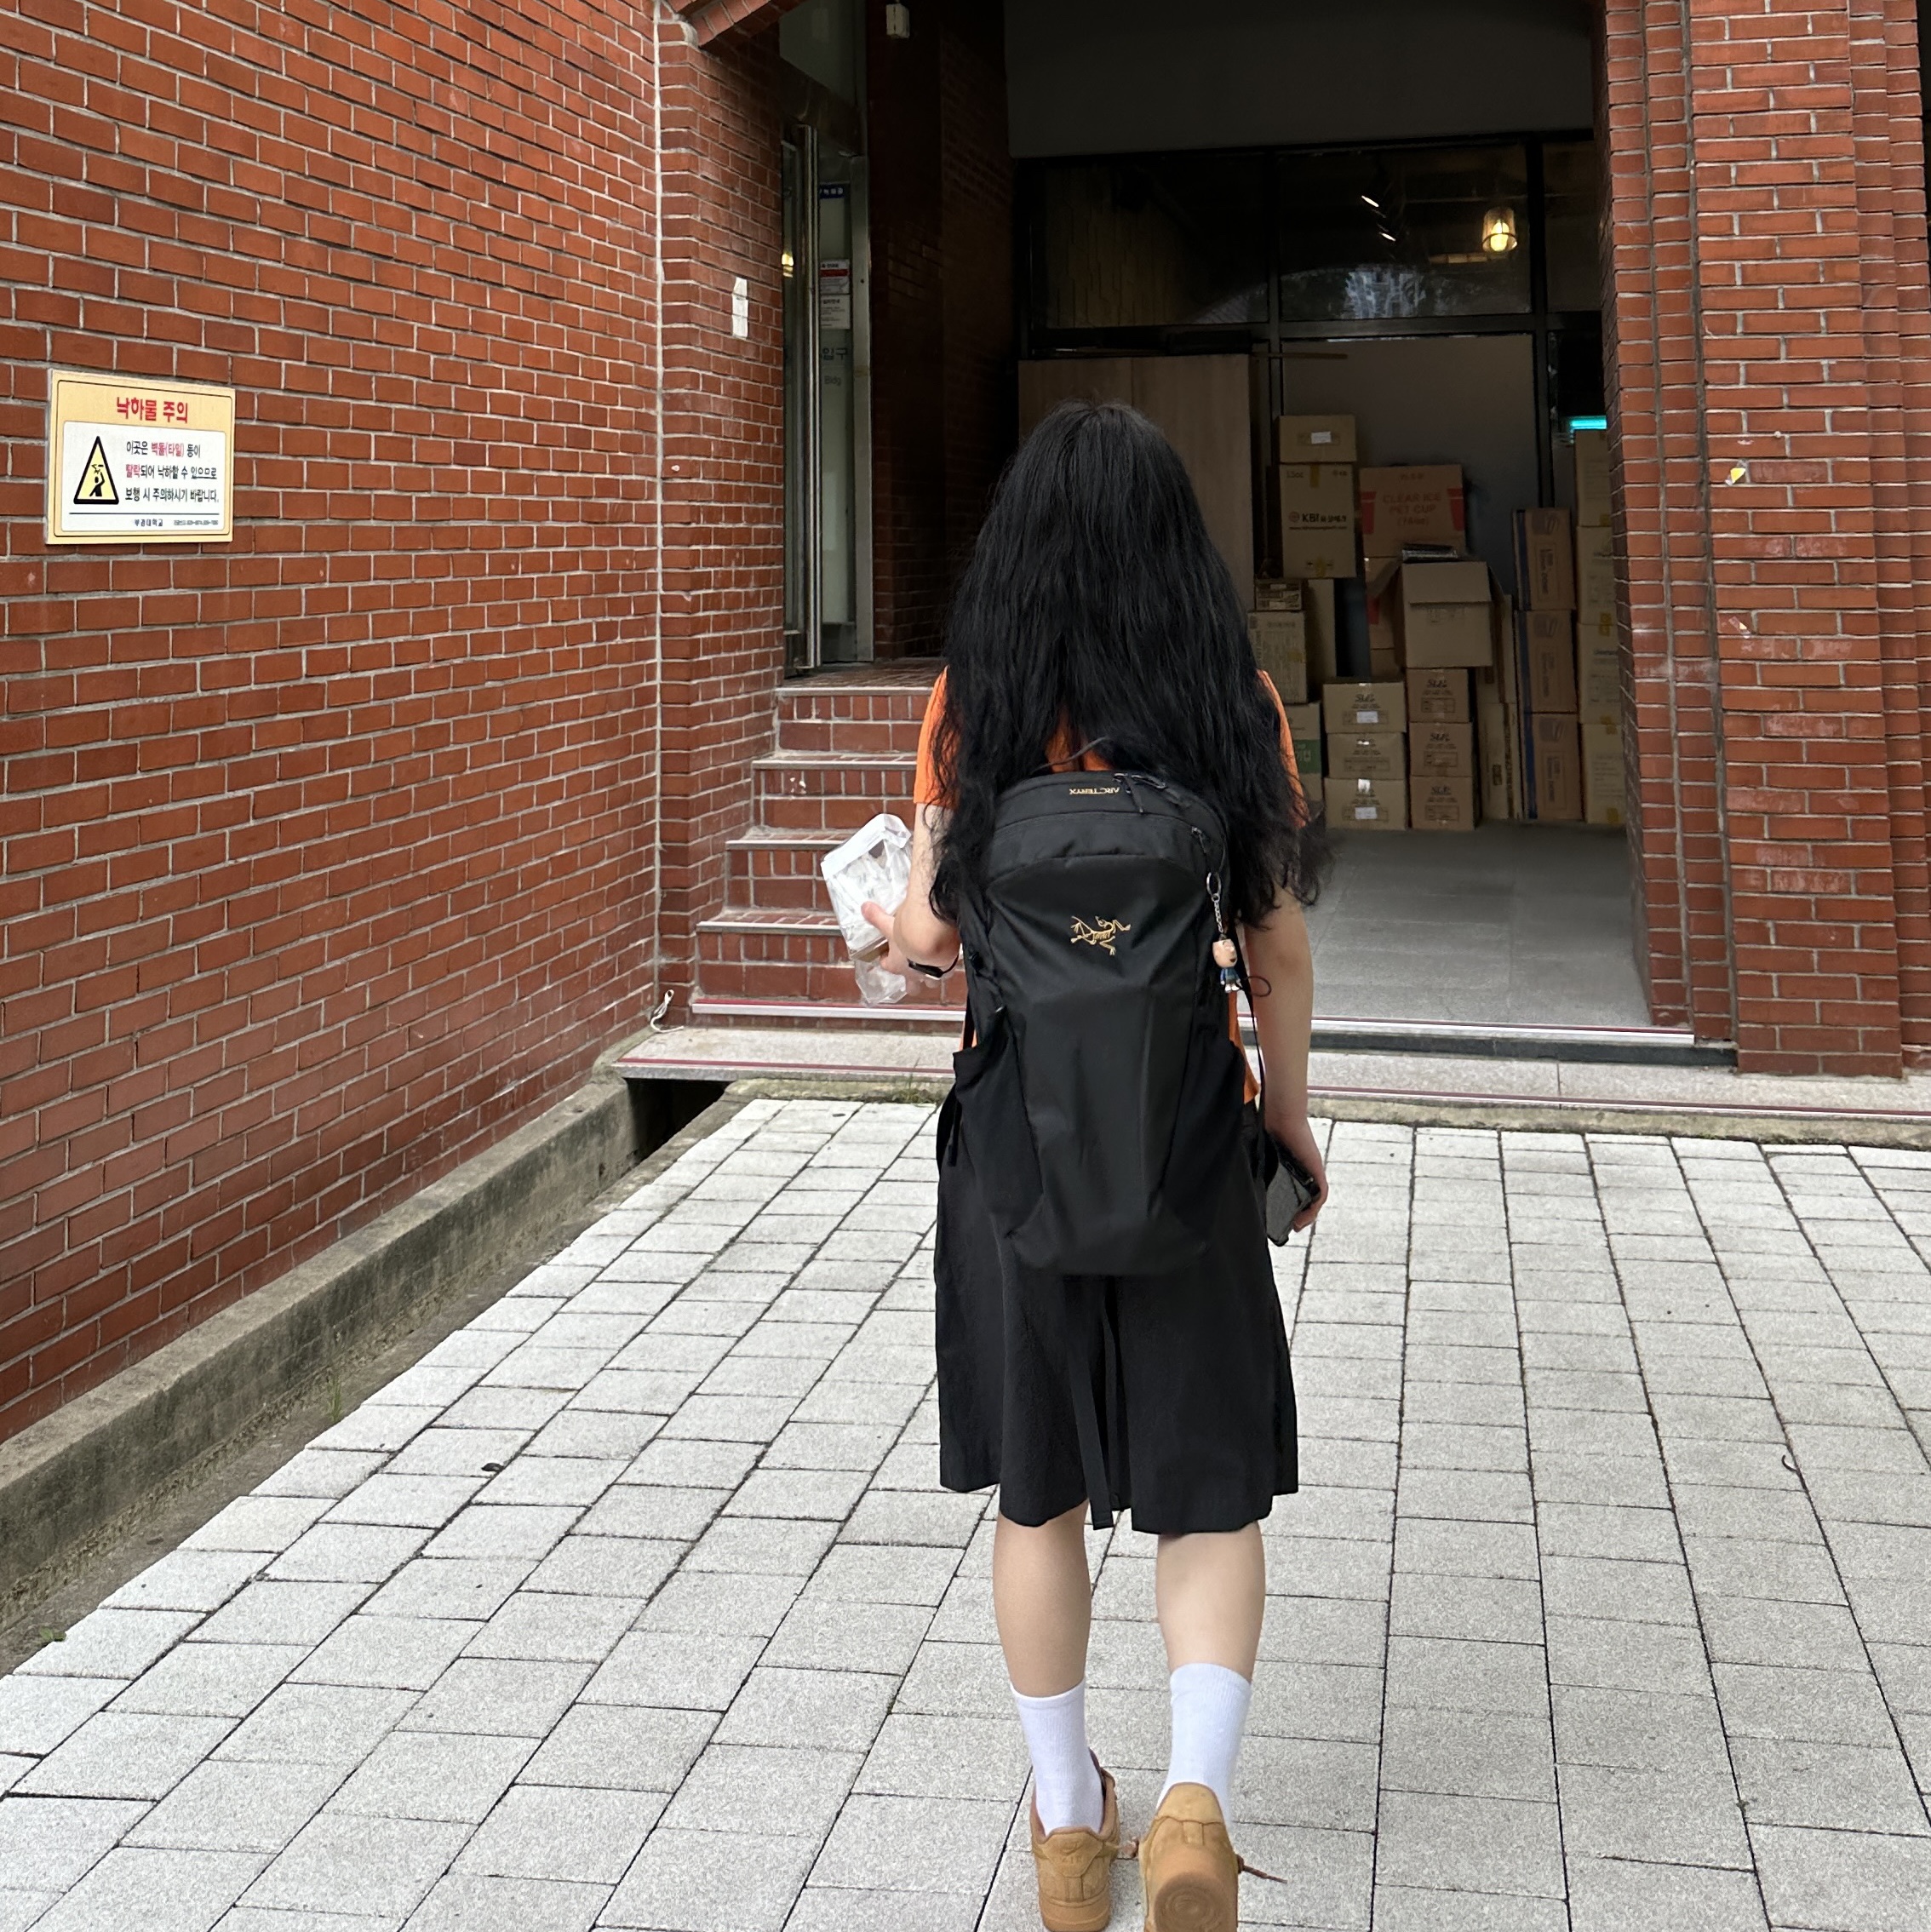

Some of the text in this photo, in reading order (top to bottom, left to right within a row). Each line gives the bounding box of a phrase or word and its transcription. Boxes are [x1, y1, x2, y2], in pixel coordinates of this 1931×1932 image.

[117, 397, 188, 423] 낙하물 주의
[127, 440, 200, 458] 이곳은 벽돌(타일) 등이
[126, 464, 217, 479] 탈락되어 낙하할 수 있으므로
[125, 487, 219, 502] 보행 시 주의하시기 바랍니다.
[1383, 491, 1441, 503] CLEAR ICE
[1389, 503, 1436, 515] PET CUP
[135, 519, 163, 527] 부경대학교
